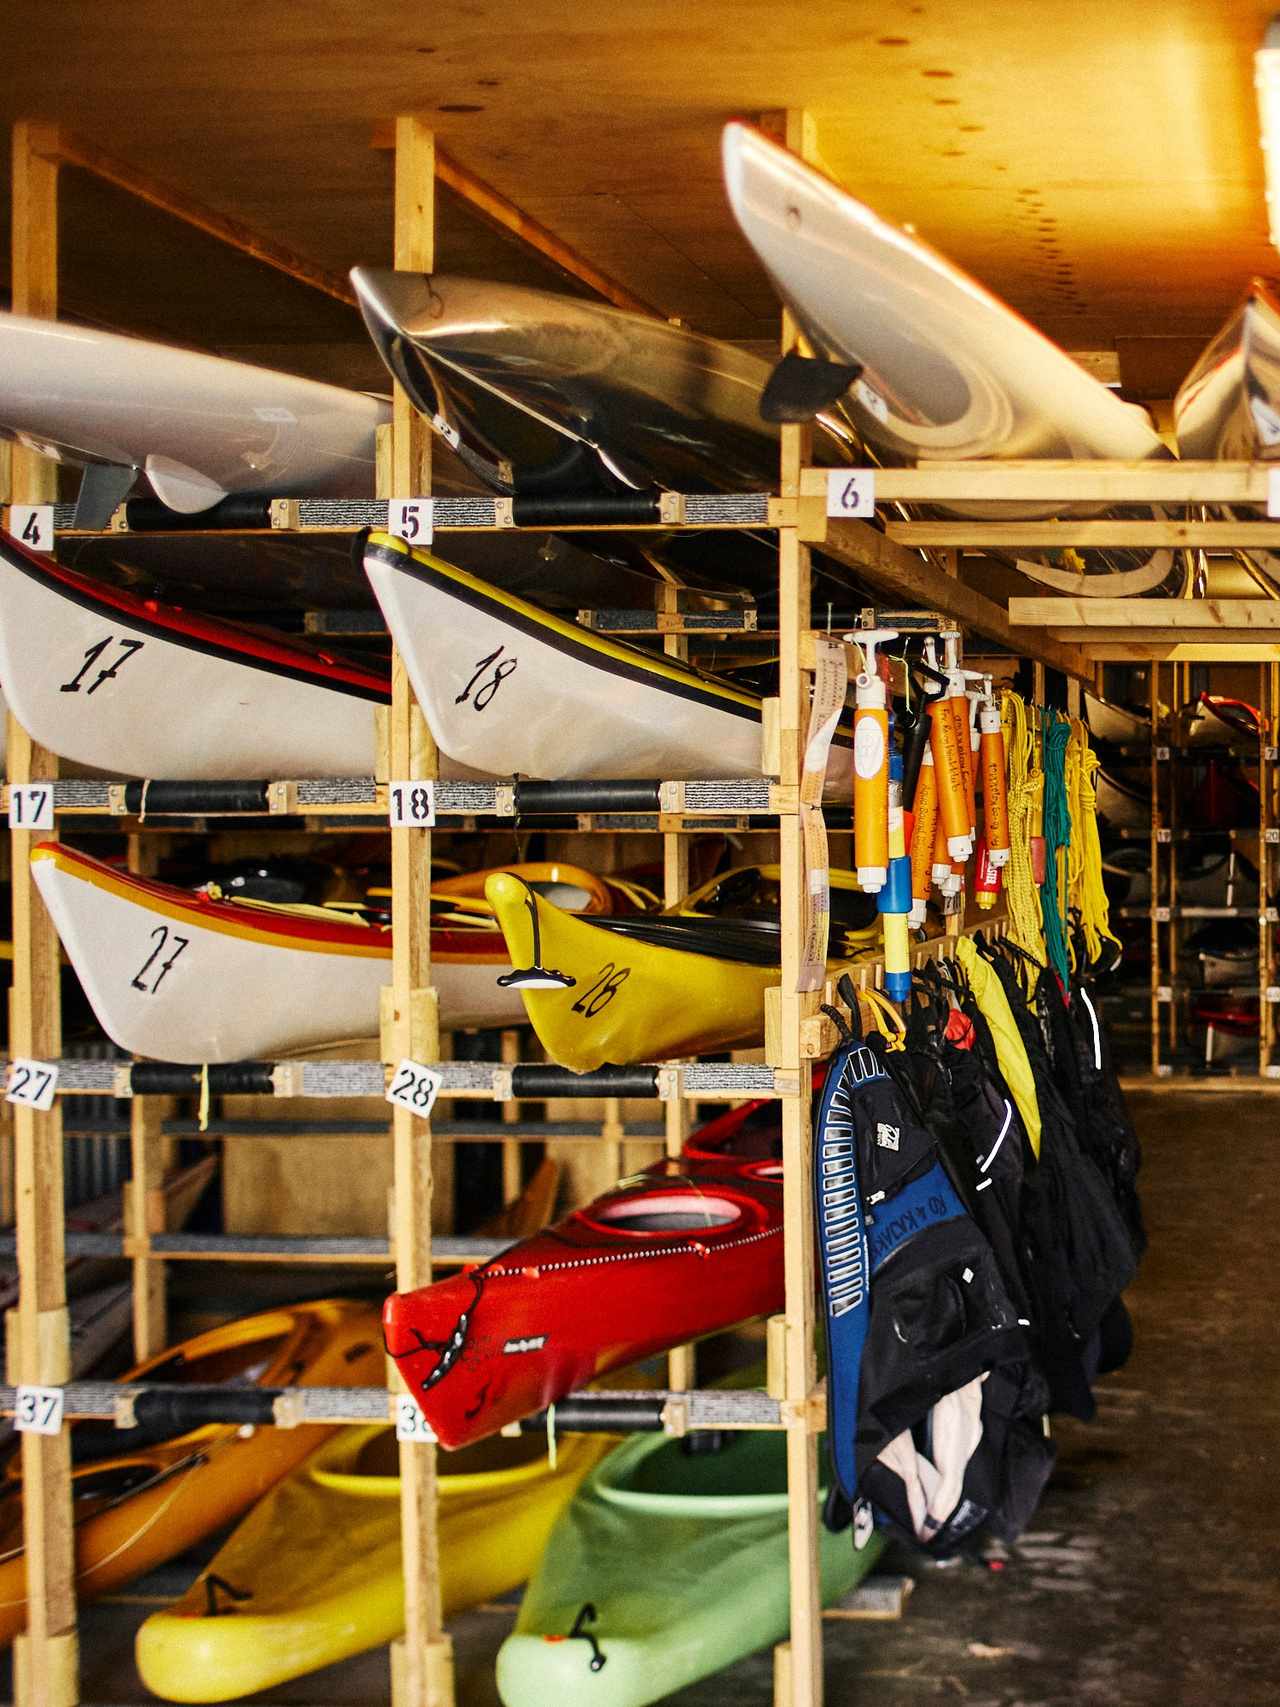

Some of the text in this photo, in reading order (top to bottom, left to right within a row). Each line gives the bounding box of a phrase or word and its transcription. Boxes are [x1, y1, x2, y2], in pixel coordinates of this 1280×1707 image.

[840, 478, 860, 509] 6
[22, 512, 41, 545] 4
[401, 505, 420, 539] 5
[59, 635, 145, 695] 17
[454, 645, 518, 712] 18
[1267, 749, 1275, 759] 7
[11, 791, 46, 823] 17
[392, 788, 430, 821] 18
[1267, 831, 1278, 841] 20
[131, 925, 190, 994] 27
[571, 963, 631, 1018] 28
[12, 1069, 53, 1102] 27
[397, 1073, 434, 1109] 28
[22, 1394, 58, 1426] 37
